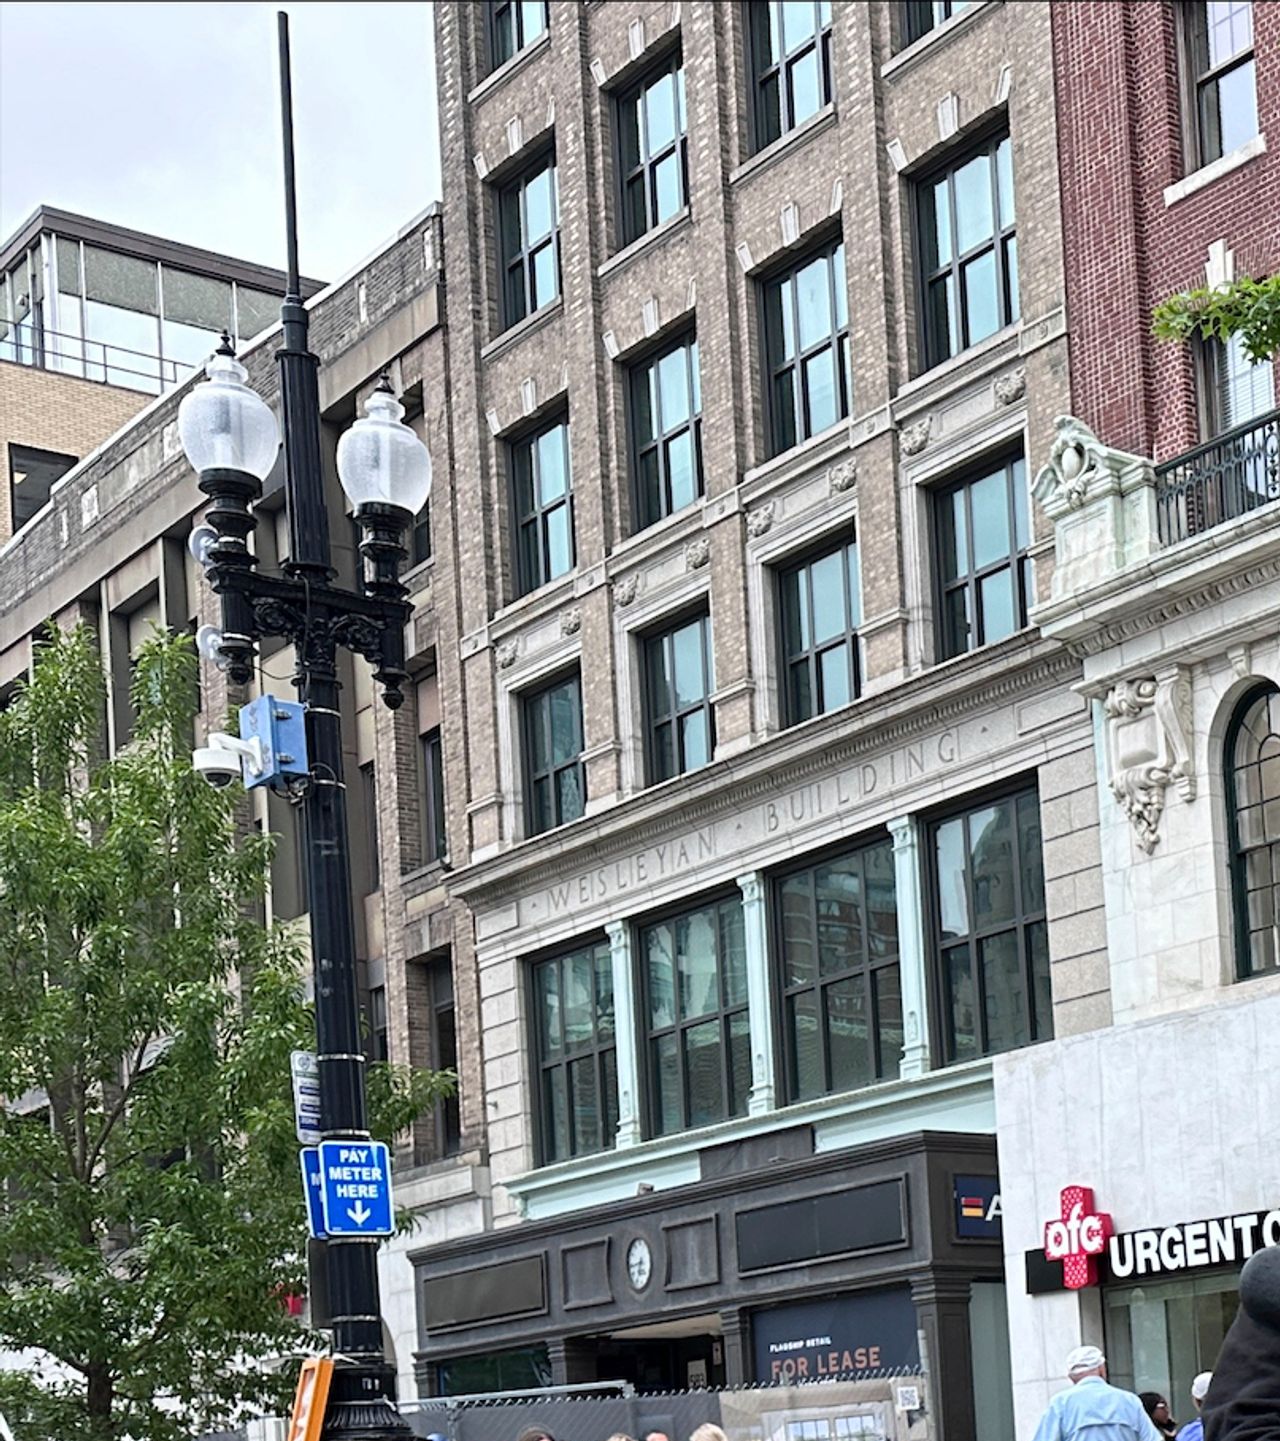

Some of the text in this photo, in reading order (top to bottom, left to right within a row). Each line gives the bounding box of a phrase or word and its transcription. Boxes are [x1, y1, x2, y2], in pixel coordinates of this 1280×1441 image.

[550, 731, 955, 911] WESLEYAN BUILDING
[339, 1149, 369, 1163] PAY
[329, 1166, 383, 1181] METER
[336, 1184, 379, 1199] HERE
[1046, 1202, 1104, 1257] afc
[1110, 1214, 1259, 1277] URGENT
[771, 1347, 881, 1381] FOR LEASE
